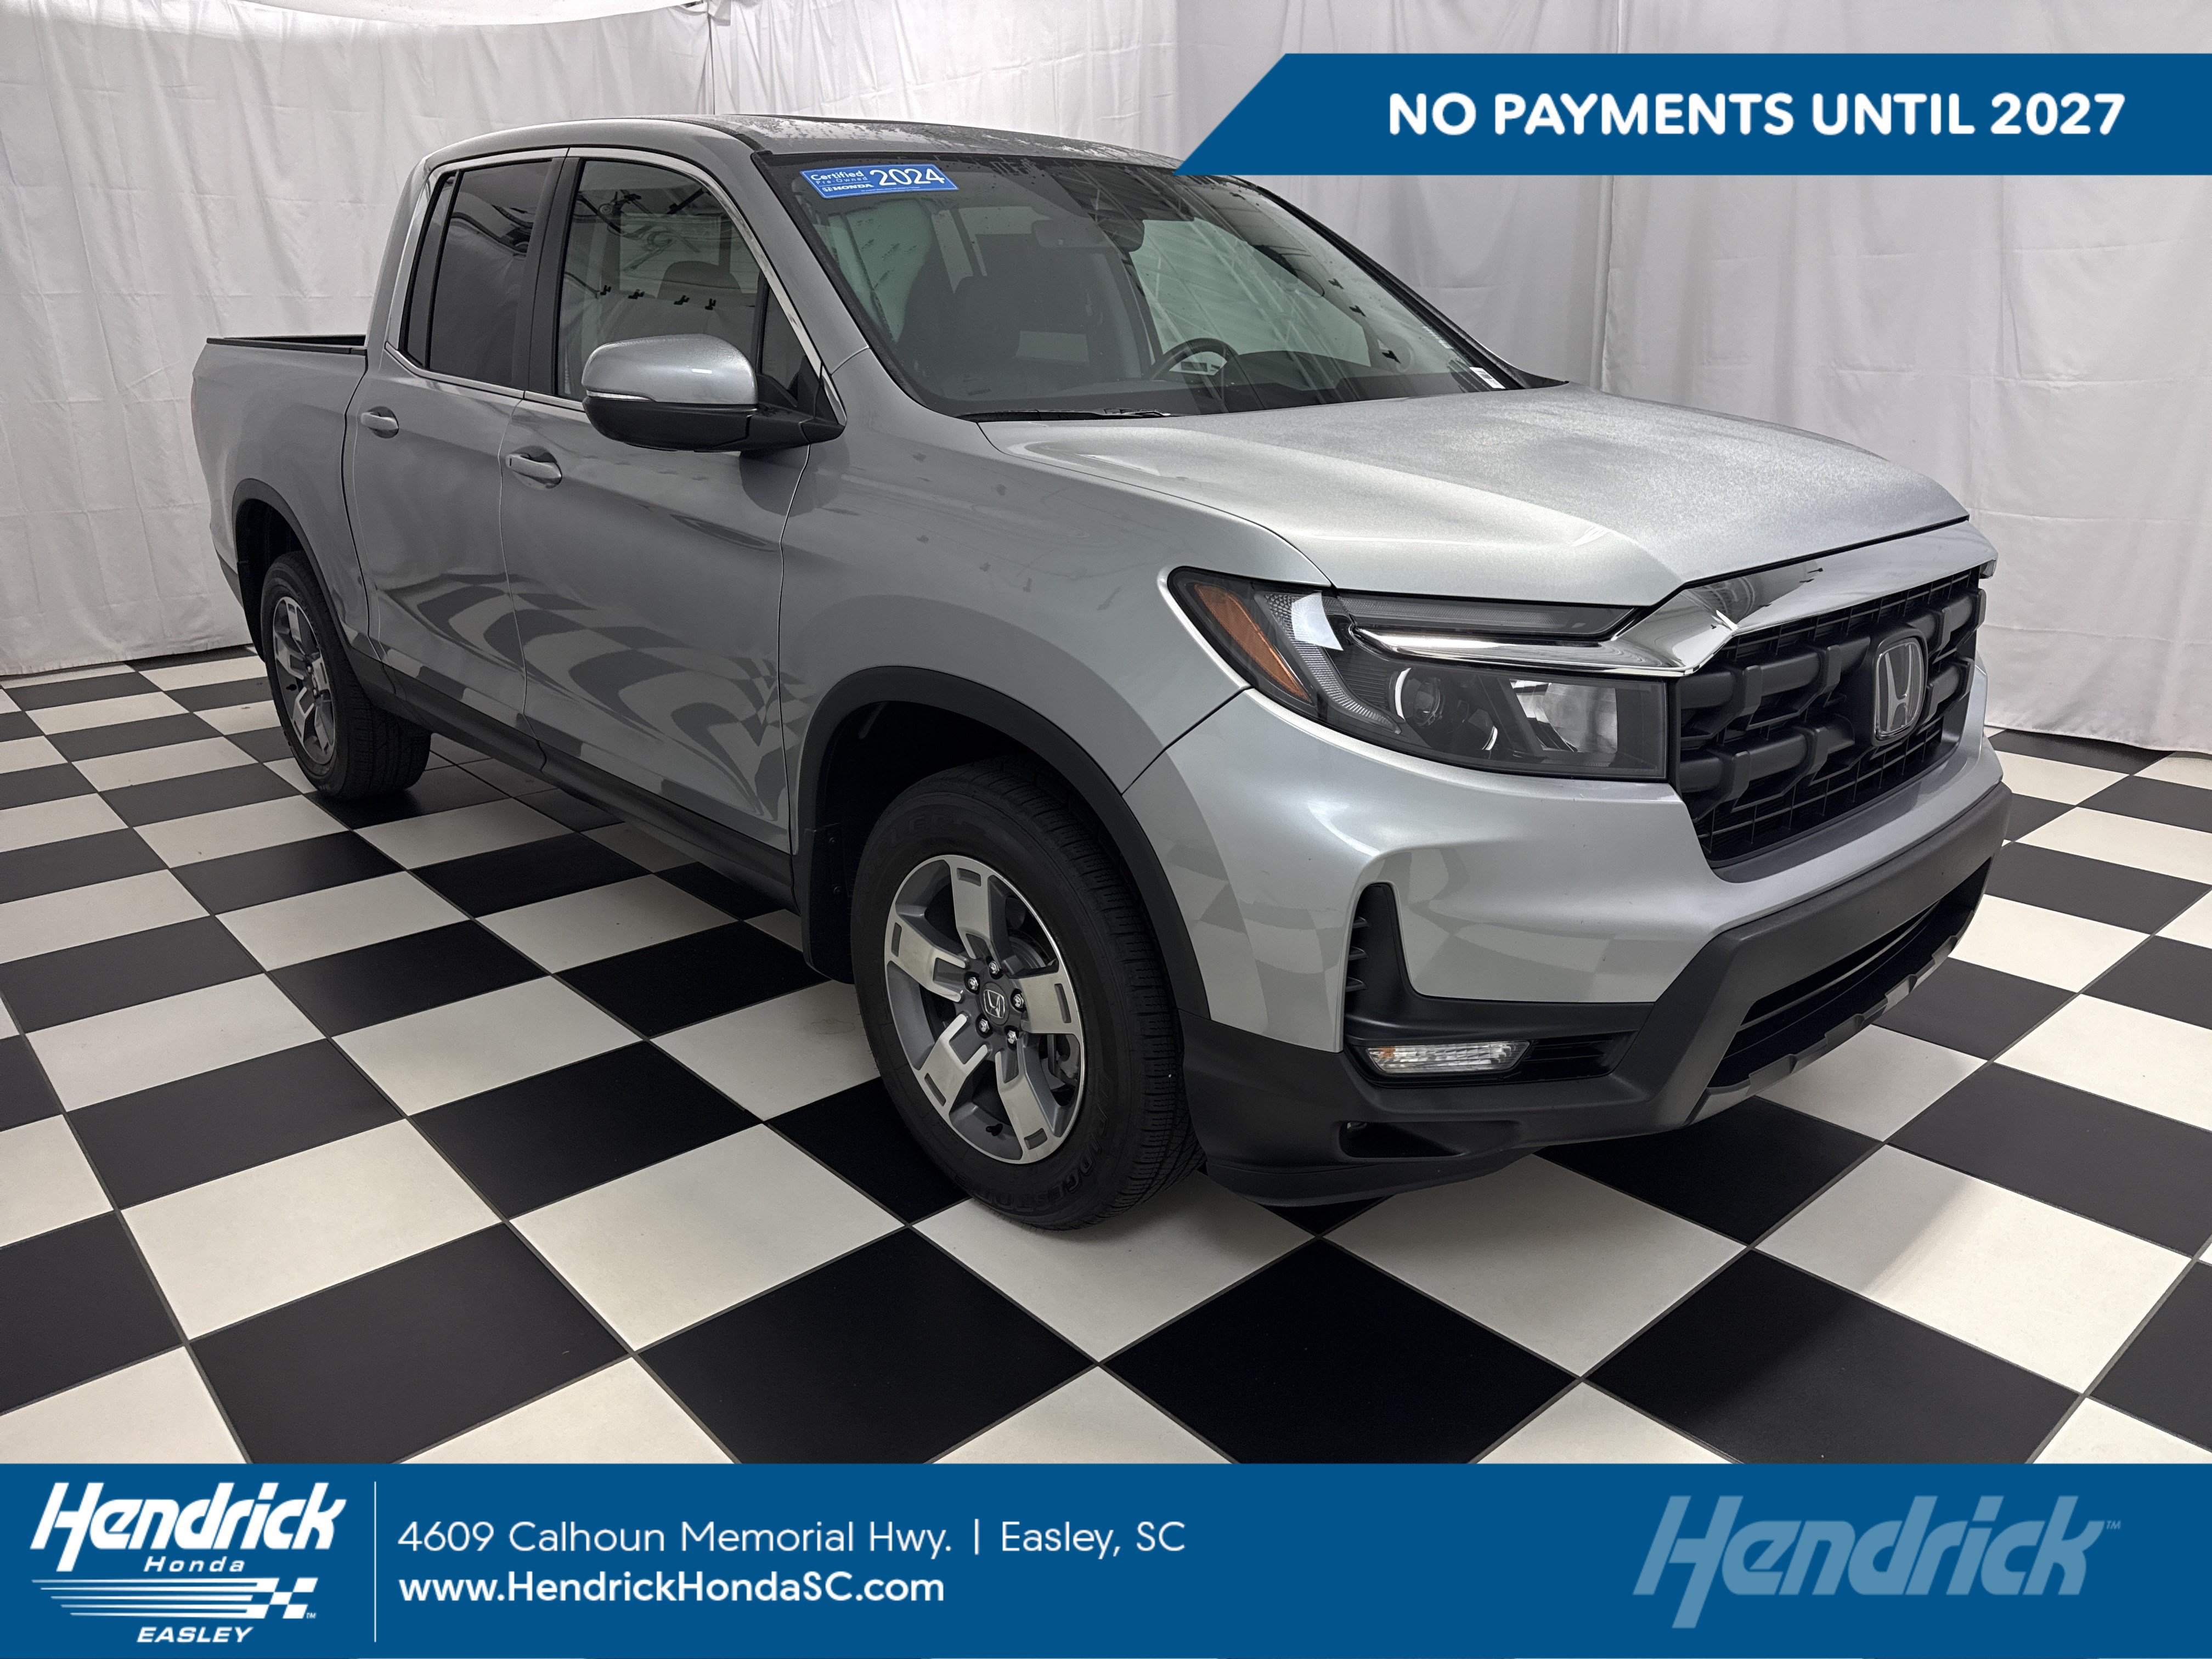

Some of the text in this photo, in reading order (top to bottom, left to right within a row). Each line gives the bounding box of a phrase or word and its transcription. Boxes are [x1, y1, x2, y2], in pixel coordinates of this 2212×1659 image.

[810, 170, 864, 180] Certified
[869, 168, 945, 186] 2024
[815, 176, 868, 185] Pre-Owned
